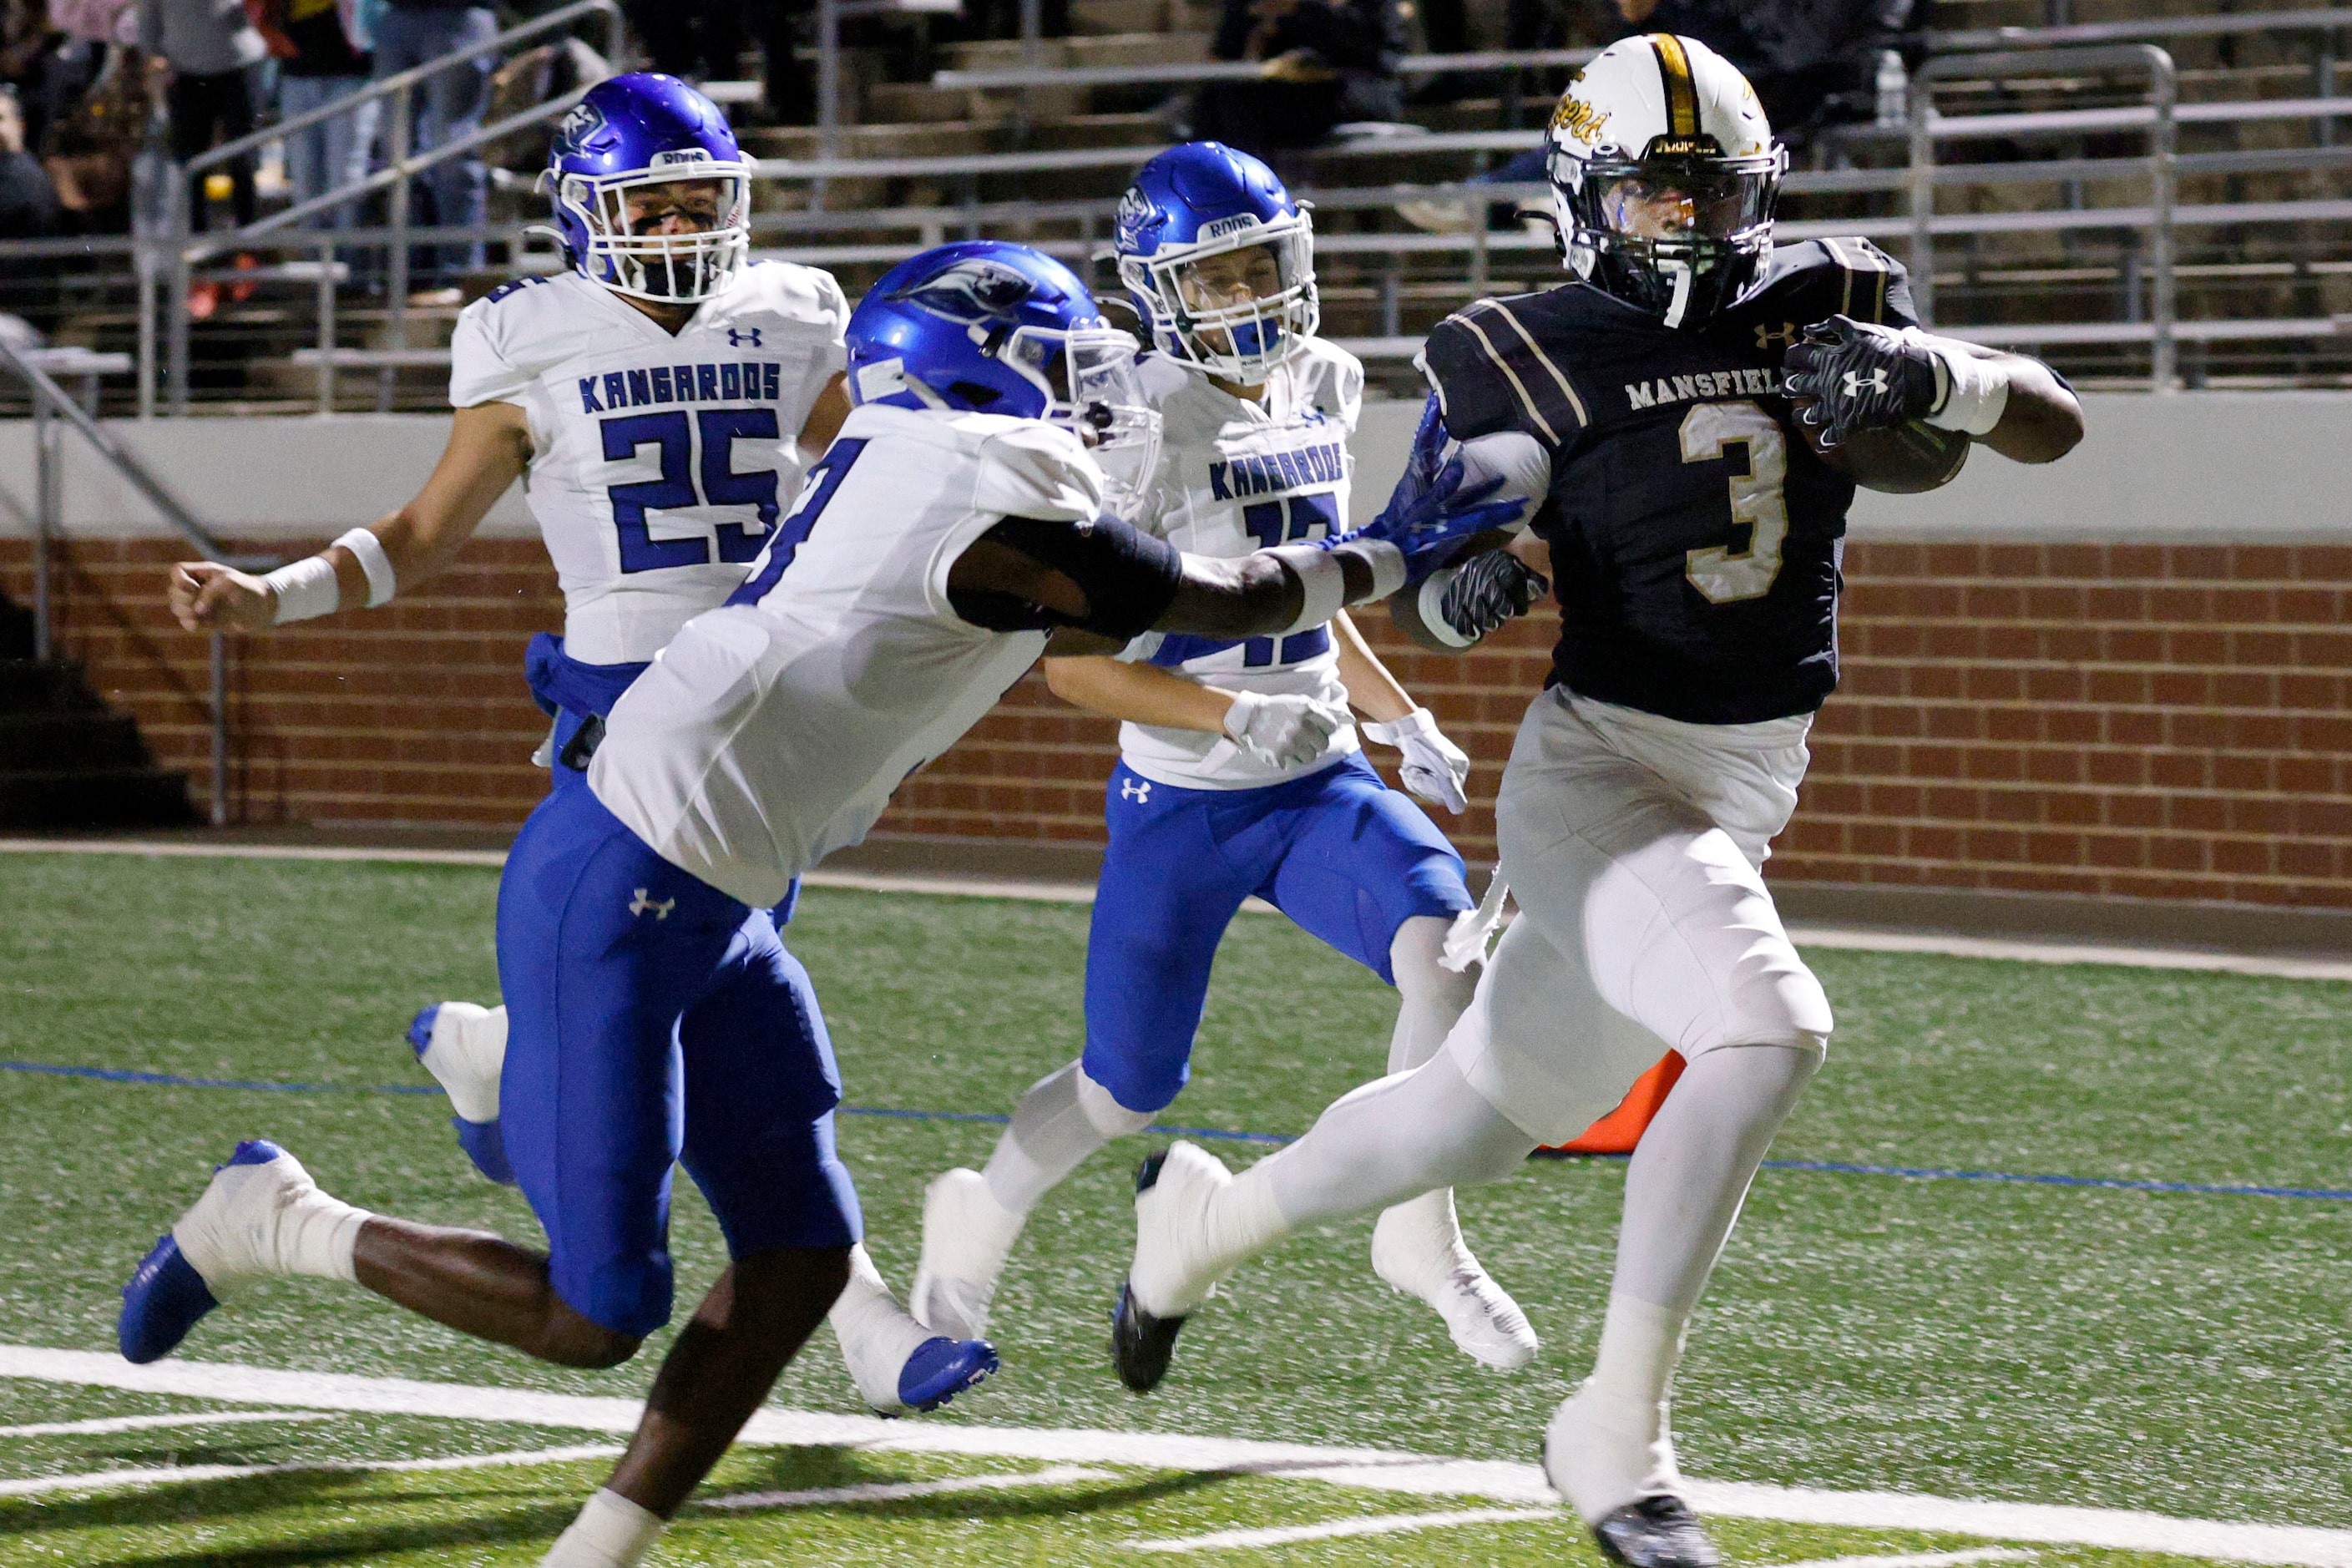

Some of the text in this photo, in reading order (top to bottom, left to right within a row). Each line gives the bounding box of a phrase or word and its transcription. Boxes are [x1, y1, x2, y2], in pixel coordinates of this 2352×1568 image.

[579, 362, 781, 414] KANGAROOS
[1625, 367, 1781, 411] MANSFIEL
[599, 408, 780, 574] 25
[1678, 399, 1789, 604] 3
